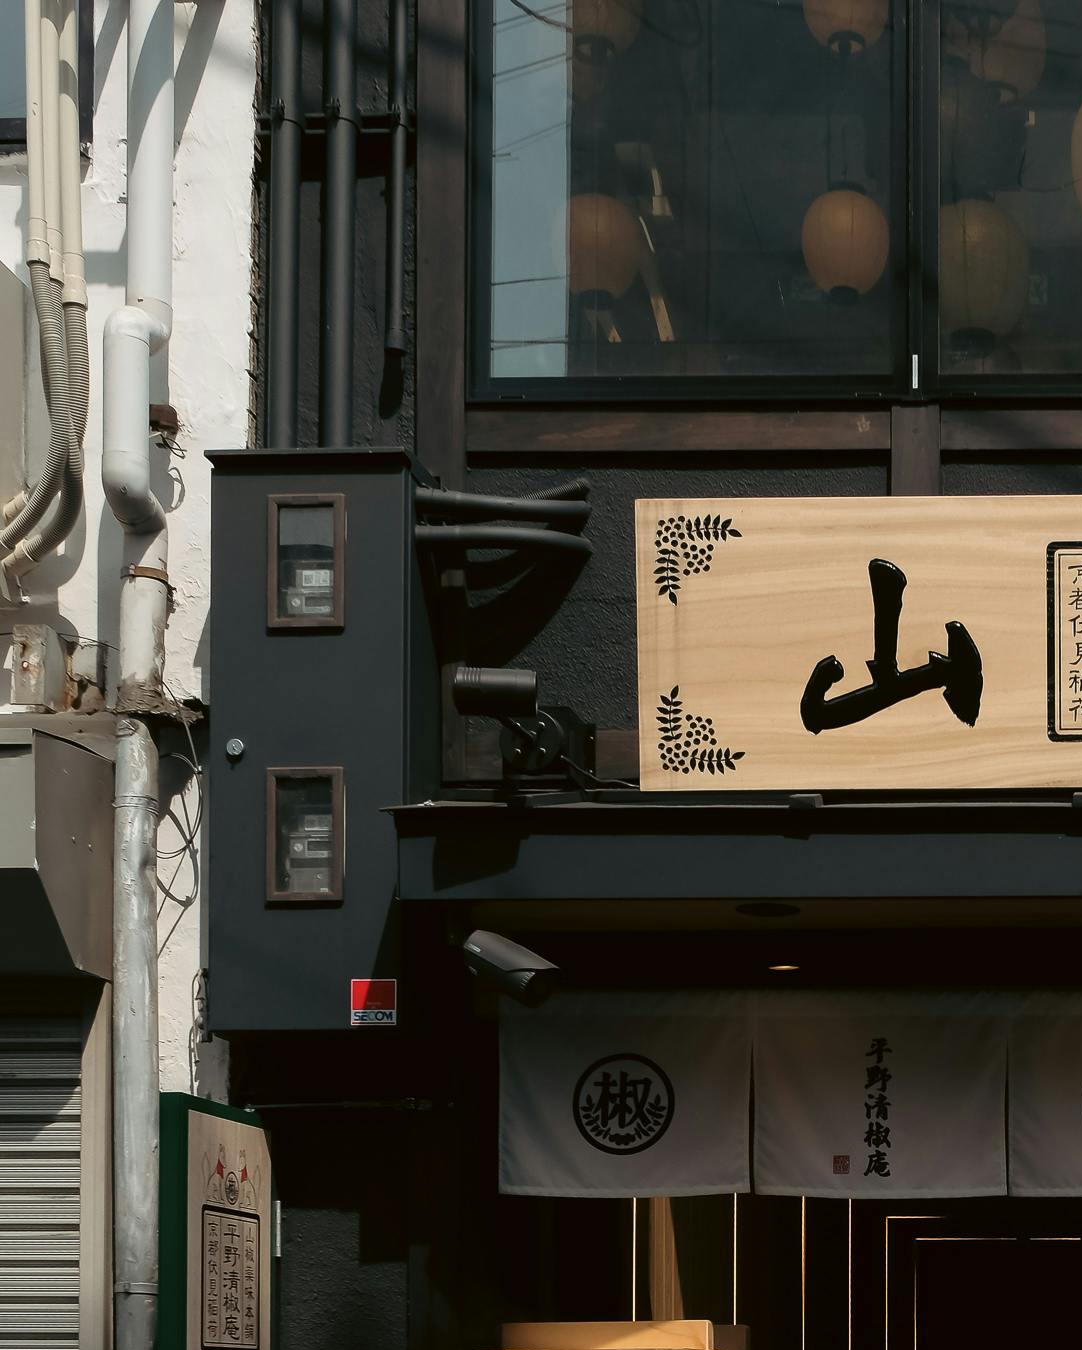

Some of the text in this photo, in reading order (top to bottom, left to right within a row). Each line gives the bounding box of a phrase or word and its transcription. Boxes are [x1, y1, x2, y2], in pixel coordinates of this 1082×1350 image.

[800, 558, 982, 734] 山
[353, 1011, 393, 1022] SECOM
[593, 1070, 652, 1129] 椒
[864, 1037, 893, 1177] 平野清椒庵
[223, 1223, 241, 1341] 平野清椒庵
